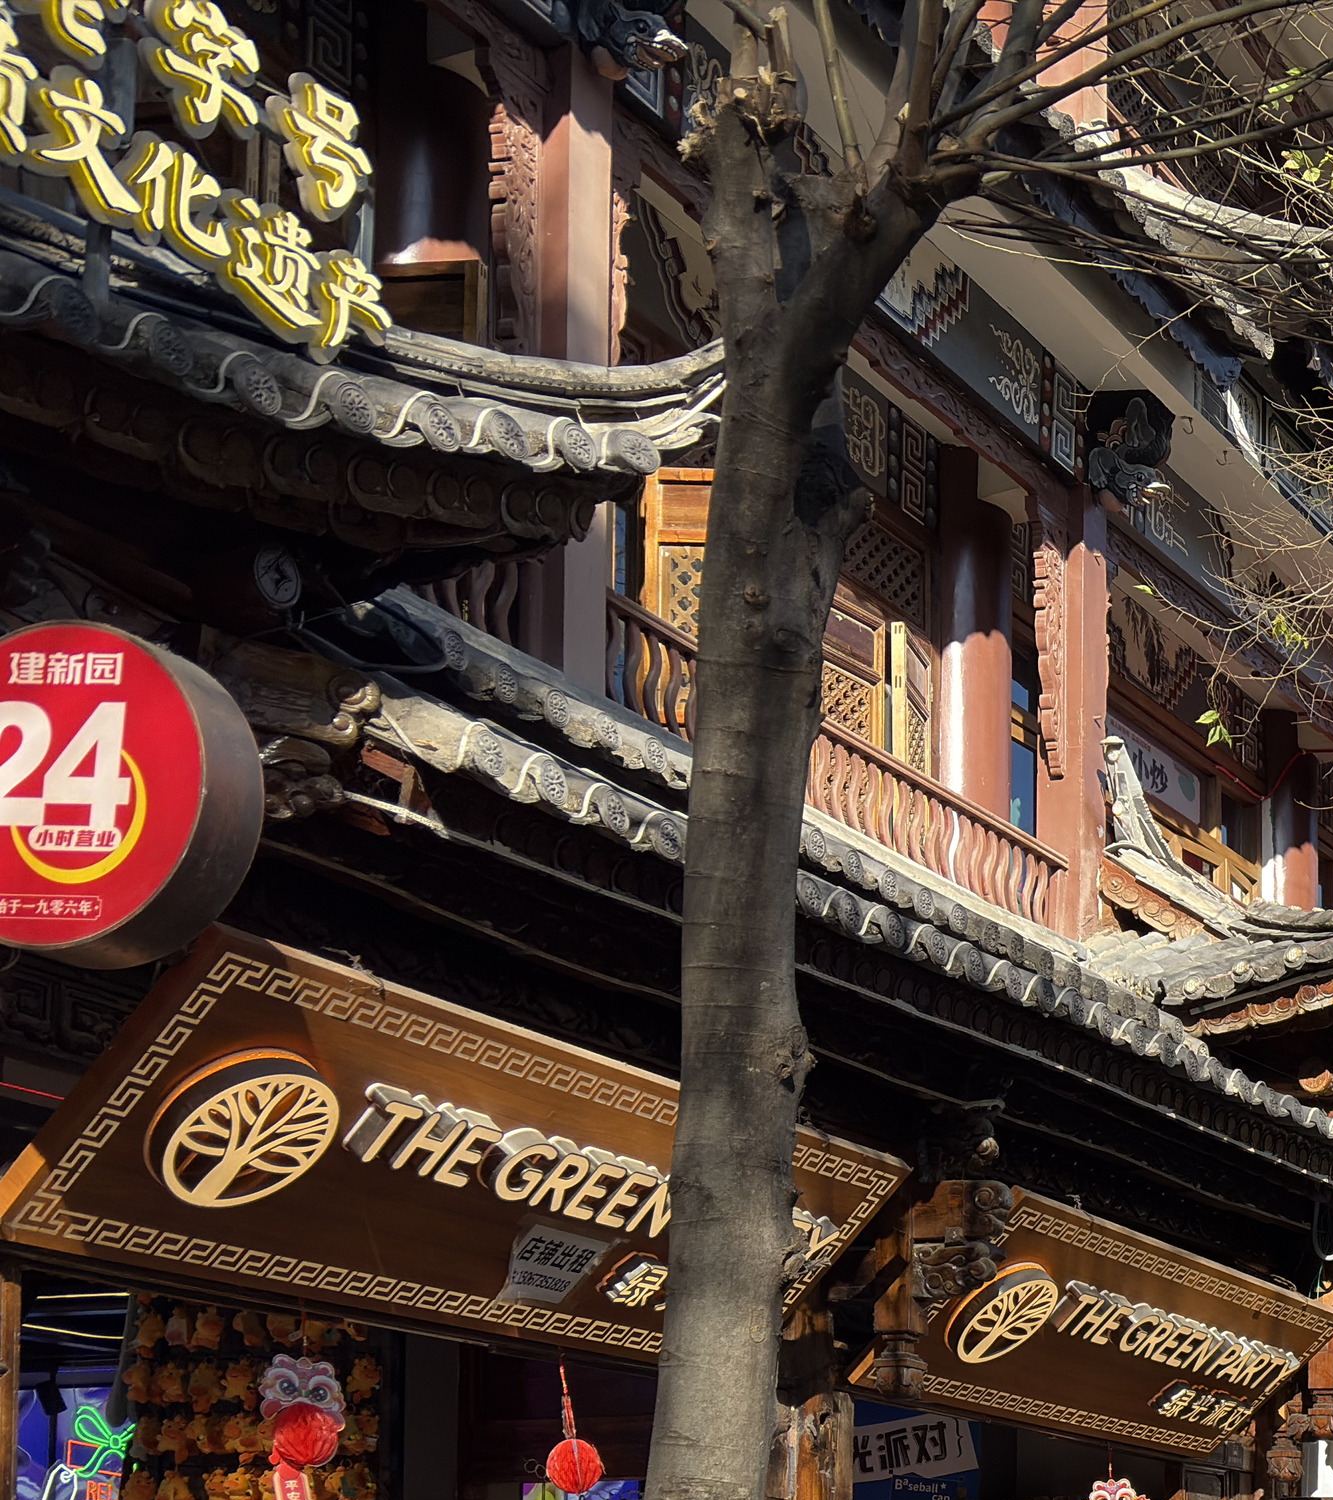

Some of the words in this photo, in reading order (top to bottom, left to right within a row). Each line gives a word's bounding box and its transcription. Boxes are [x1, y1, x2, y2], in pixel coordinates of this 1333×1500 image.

[55, 0, 374, 210] 字号
[7, 651, 125, 686] 建新园
[0, 699, 132, 828] 24
[34, 829, 117, 849] 小时营业
[361, 1099, 504, 1189] THE
[494, 1143, 673, 1239] GREEN
[516, 1236, 598, 1275] 店铺出租
[1056, 1293, 1135, 1346] THE
[1118, 1314, 1218, 1375] GREEN
[1205, 1344, 1302, 1393] PARTY
